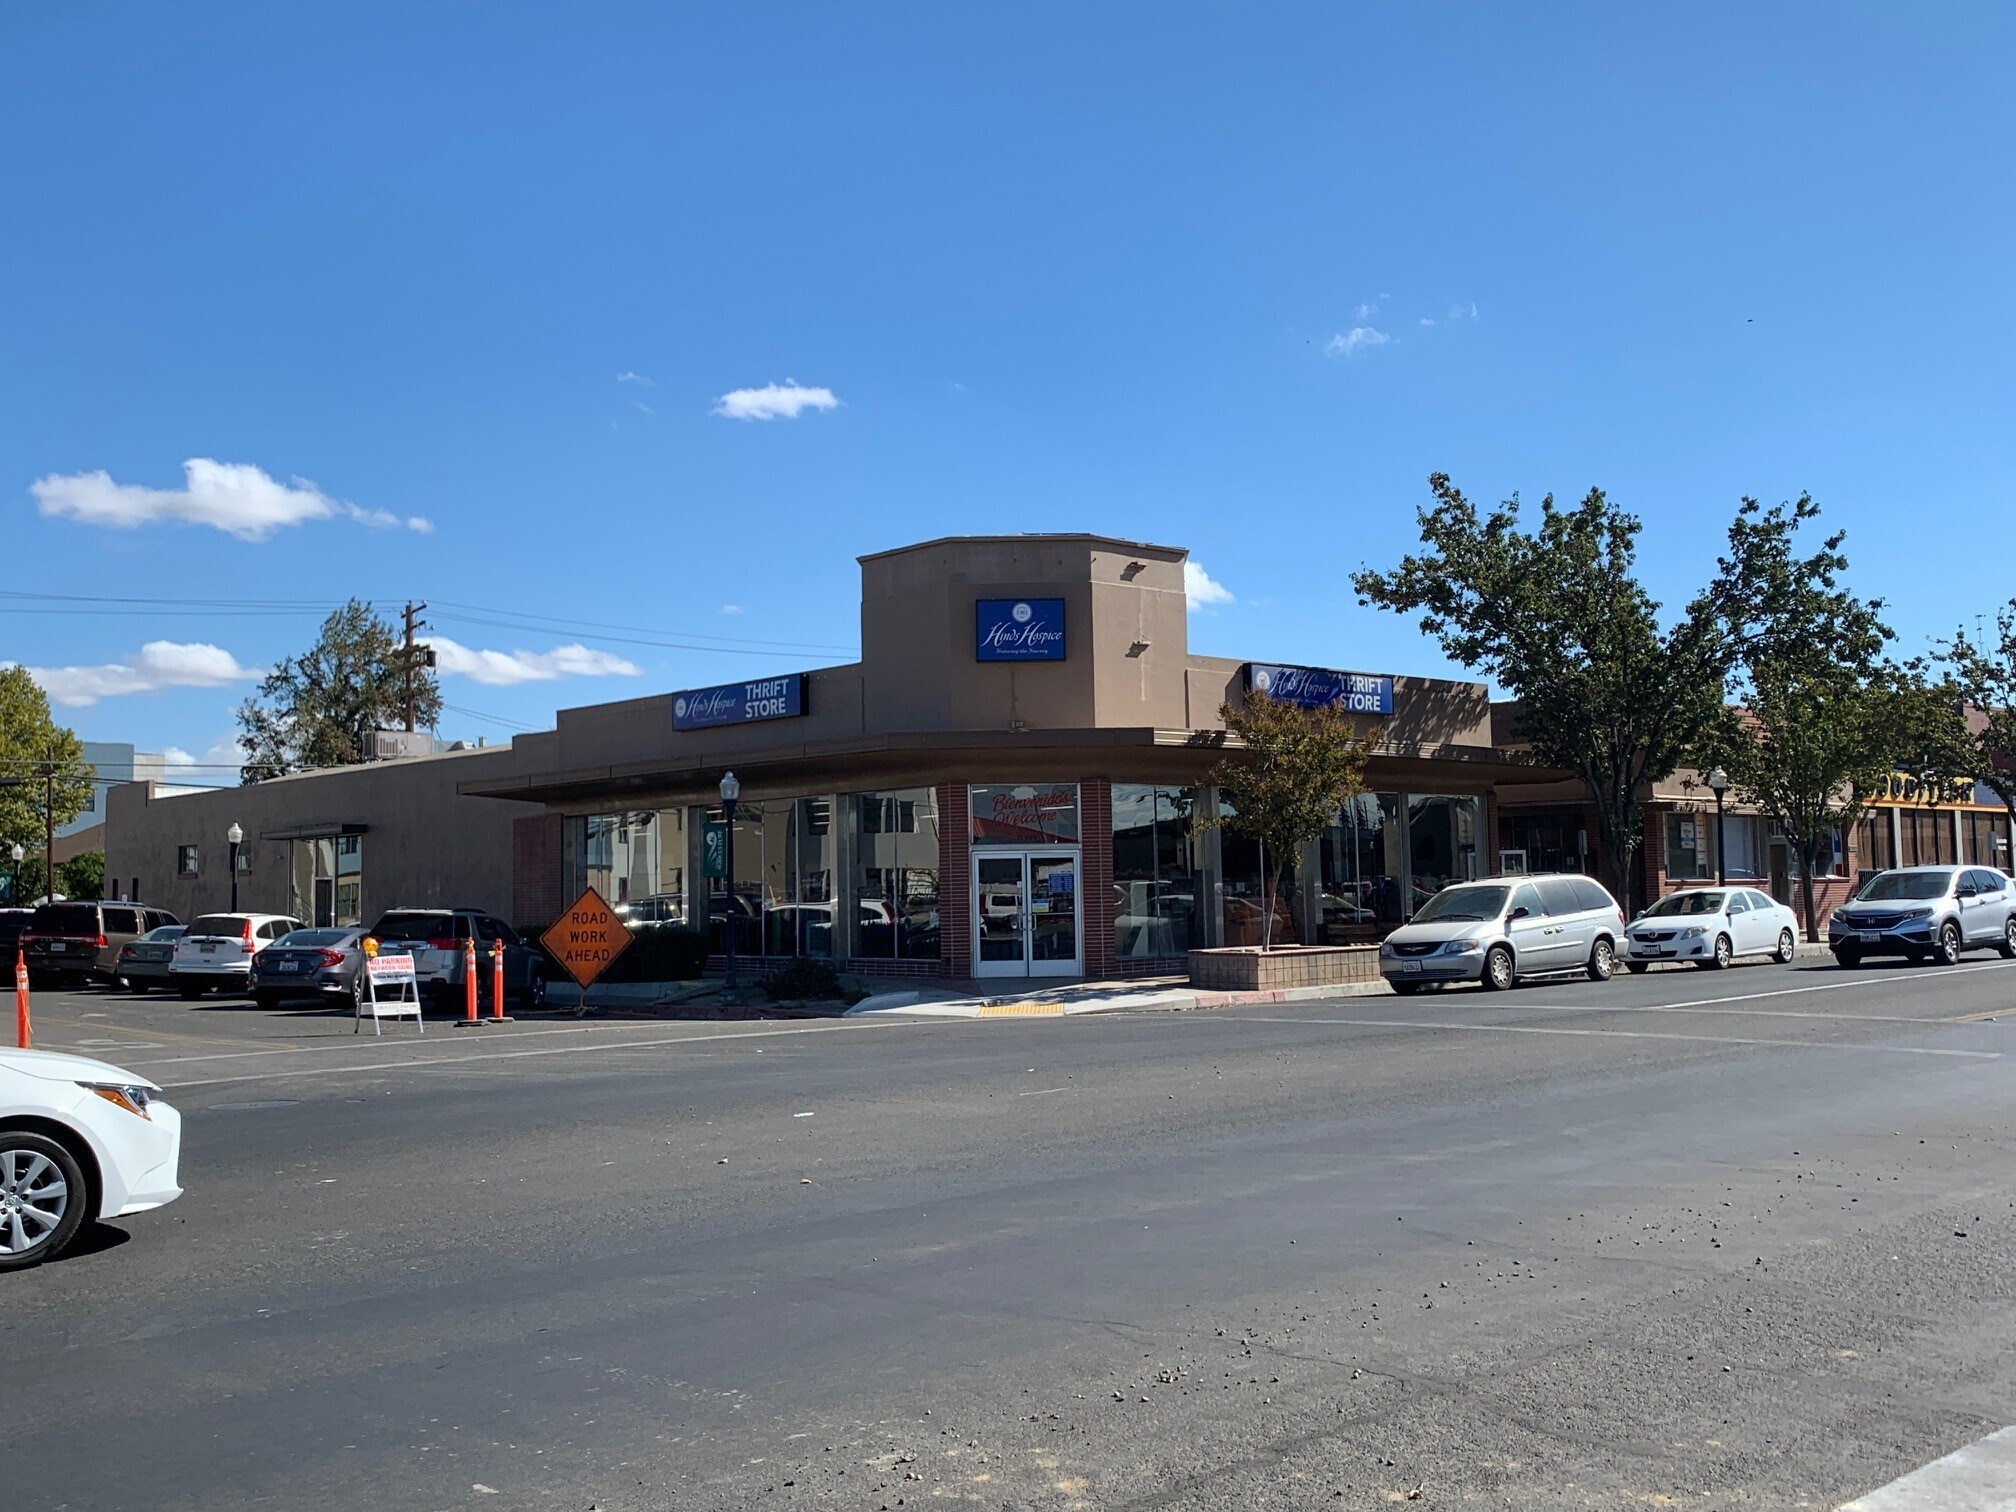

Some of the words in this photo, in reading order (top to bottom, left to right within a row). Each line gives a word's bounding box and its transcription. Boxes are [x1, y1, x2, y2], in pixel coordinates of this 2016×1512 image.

[980, 621, 1020, 647] Hinds
[1014, 621, 1062, 647] Hospice
[745, 678, 789, 700] THRIFT
[1339, 673, 1383, 694] THRIFT
[685, 692, 709, 719] Hinds
[706, 689, 736, 715] Hospice
[745, 697, 786, 719] STORE
[1340, 692, 1381, 711] STORE
[993, 810, 1057, 826] Welcome
[572, 912, 608, 925] ROAD
[570, 930, 607, 943] WORK
[369, 957, 380, 966] NO
[381, 956, 413, 965] PARKING
[565, 948, 610, 962] AHEAD
